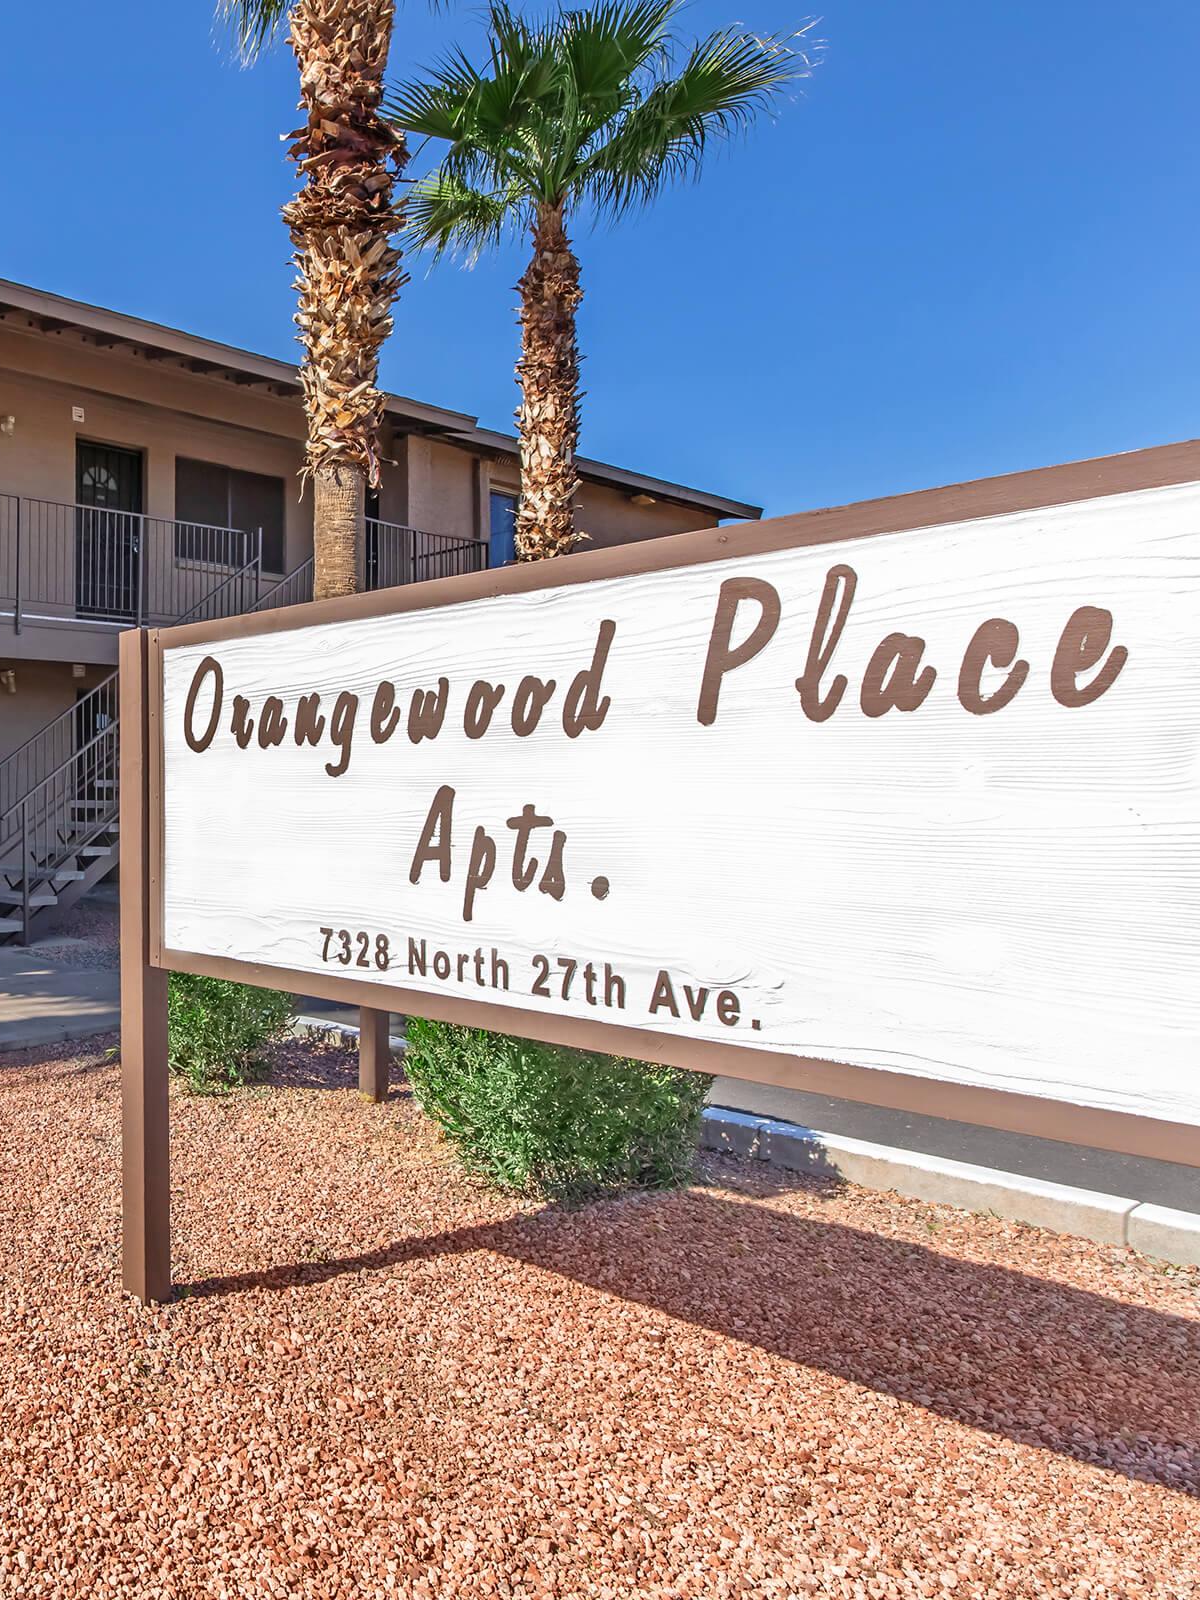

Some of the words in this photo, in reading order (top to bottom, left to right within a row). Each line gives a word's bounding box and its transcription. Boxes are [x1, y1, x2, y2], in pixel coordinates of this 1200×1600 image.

[183, 619, 617, 778] Orangewood
[696, 563, 1129, 727] Place
[408, 784, 610, 922] Apts.
[319, 927, 394, 972] 7328
[407, 936, 509, 991] North
[531, 954, 626, 1010] 27th
[648, 970, 762, 1031] Ave.
